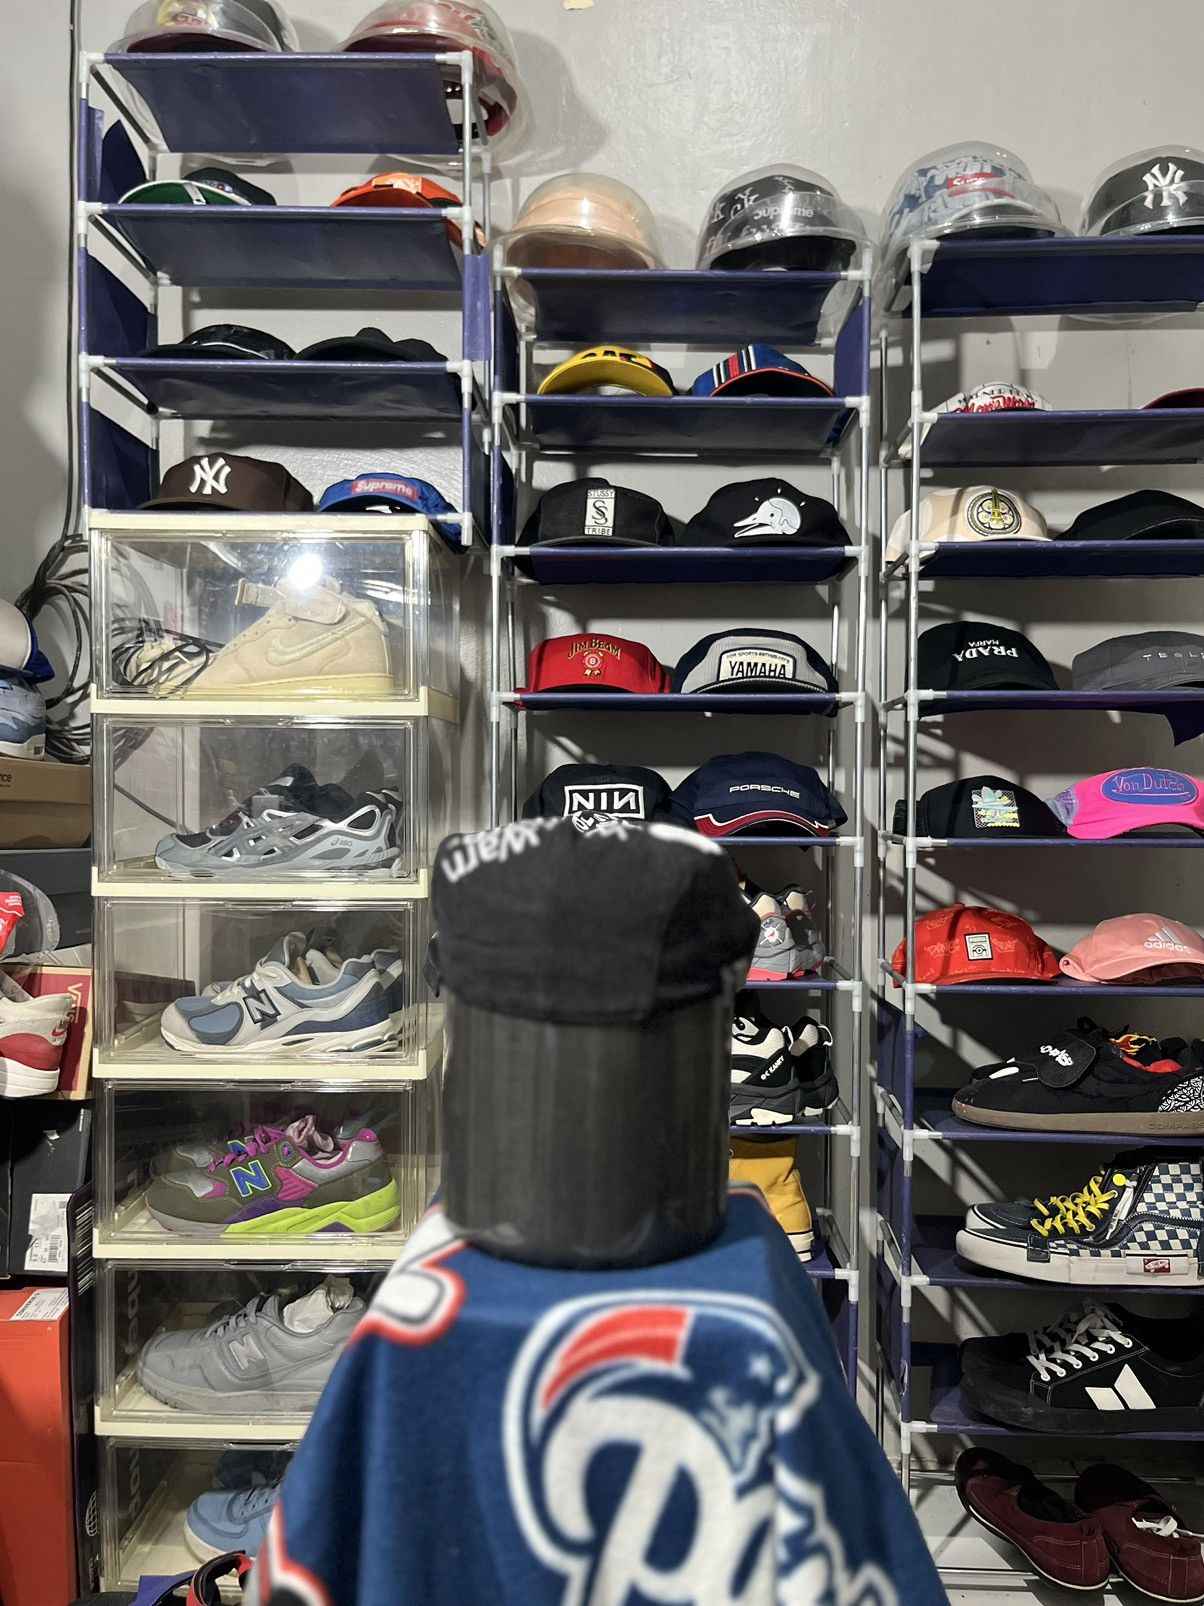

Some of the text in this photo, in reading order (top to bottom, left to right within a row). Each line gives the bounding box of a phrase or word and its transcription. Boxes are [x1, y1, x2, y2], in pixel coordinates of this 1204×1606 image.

[1142, 162, 1189, 209] NY
[753, 206, 814, 220] Supme
[190, 457, 232, 495] NY
[586, 527, 612, 535] TRIBE
[952, 645, 1019, 662] PRADA
[729, 661, 787, 678] YAMAHA
[729, 784, 800, 799] PORSCHE
[1112, 773, 1186, 793] Von Dutch
[572, 791, 636, 811] NIN
[1143, 940, 1192, 954] adidas
